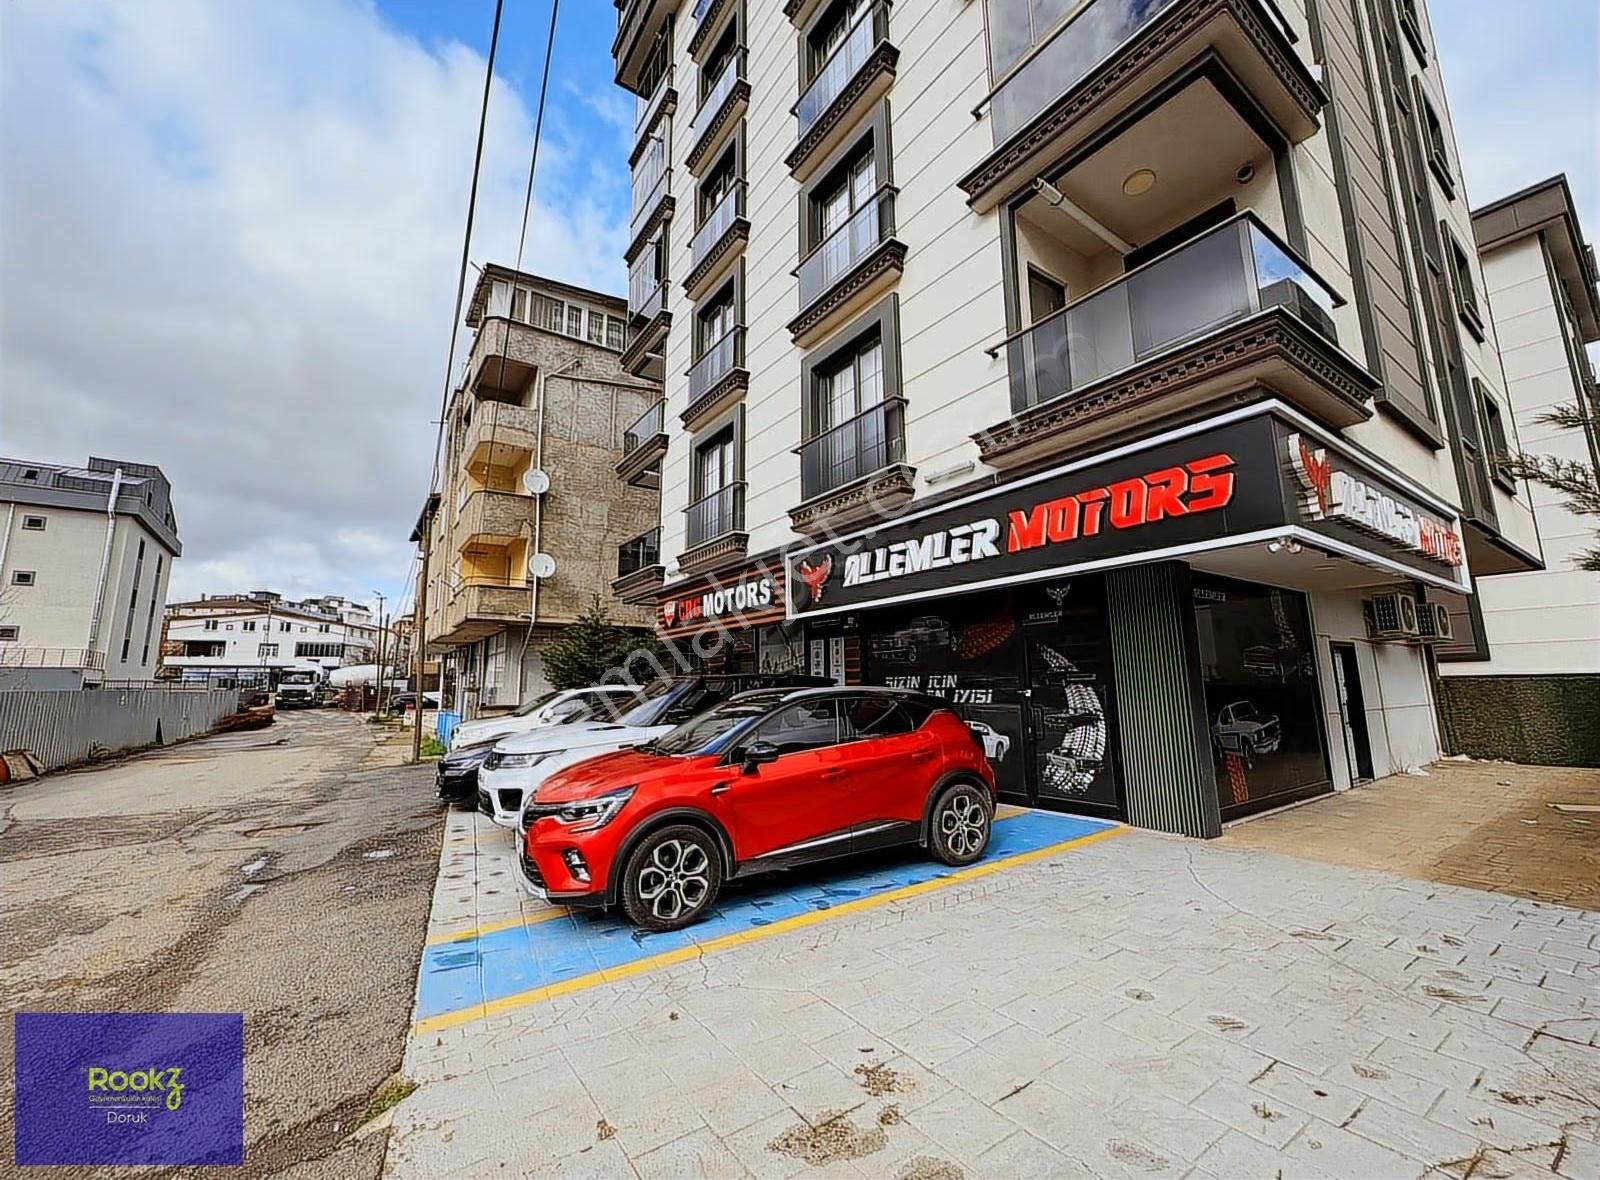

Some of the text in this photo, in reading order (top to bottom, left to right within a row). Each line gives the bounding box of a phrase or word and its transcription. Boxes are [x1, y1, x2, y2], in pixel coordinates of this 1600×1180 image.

[842, 454, 1236, 588] ALLEMLER MOTORS
[702, 578, 771, 617] MOTORS
